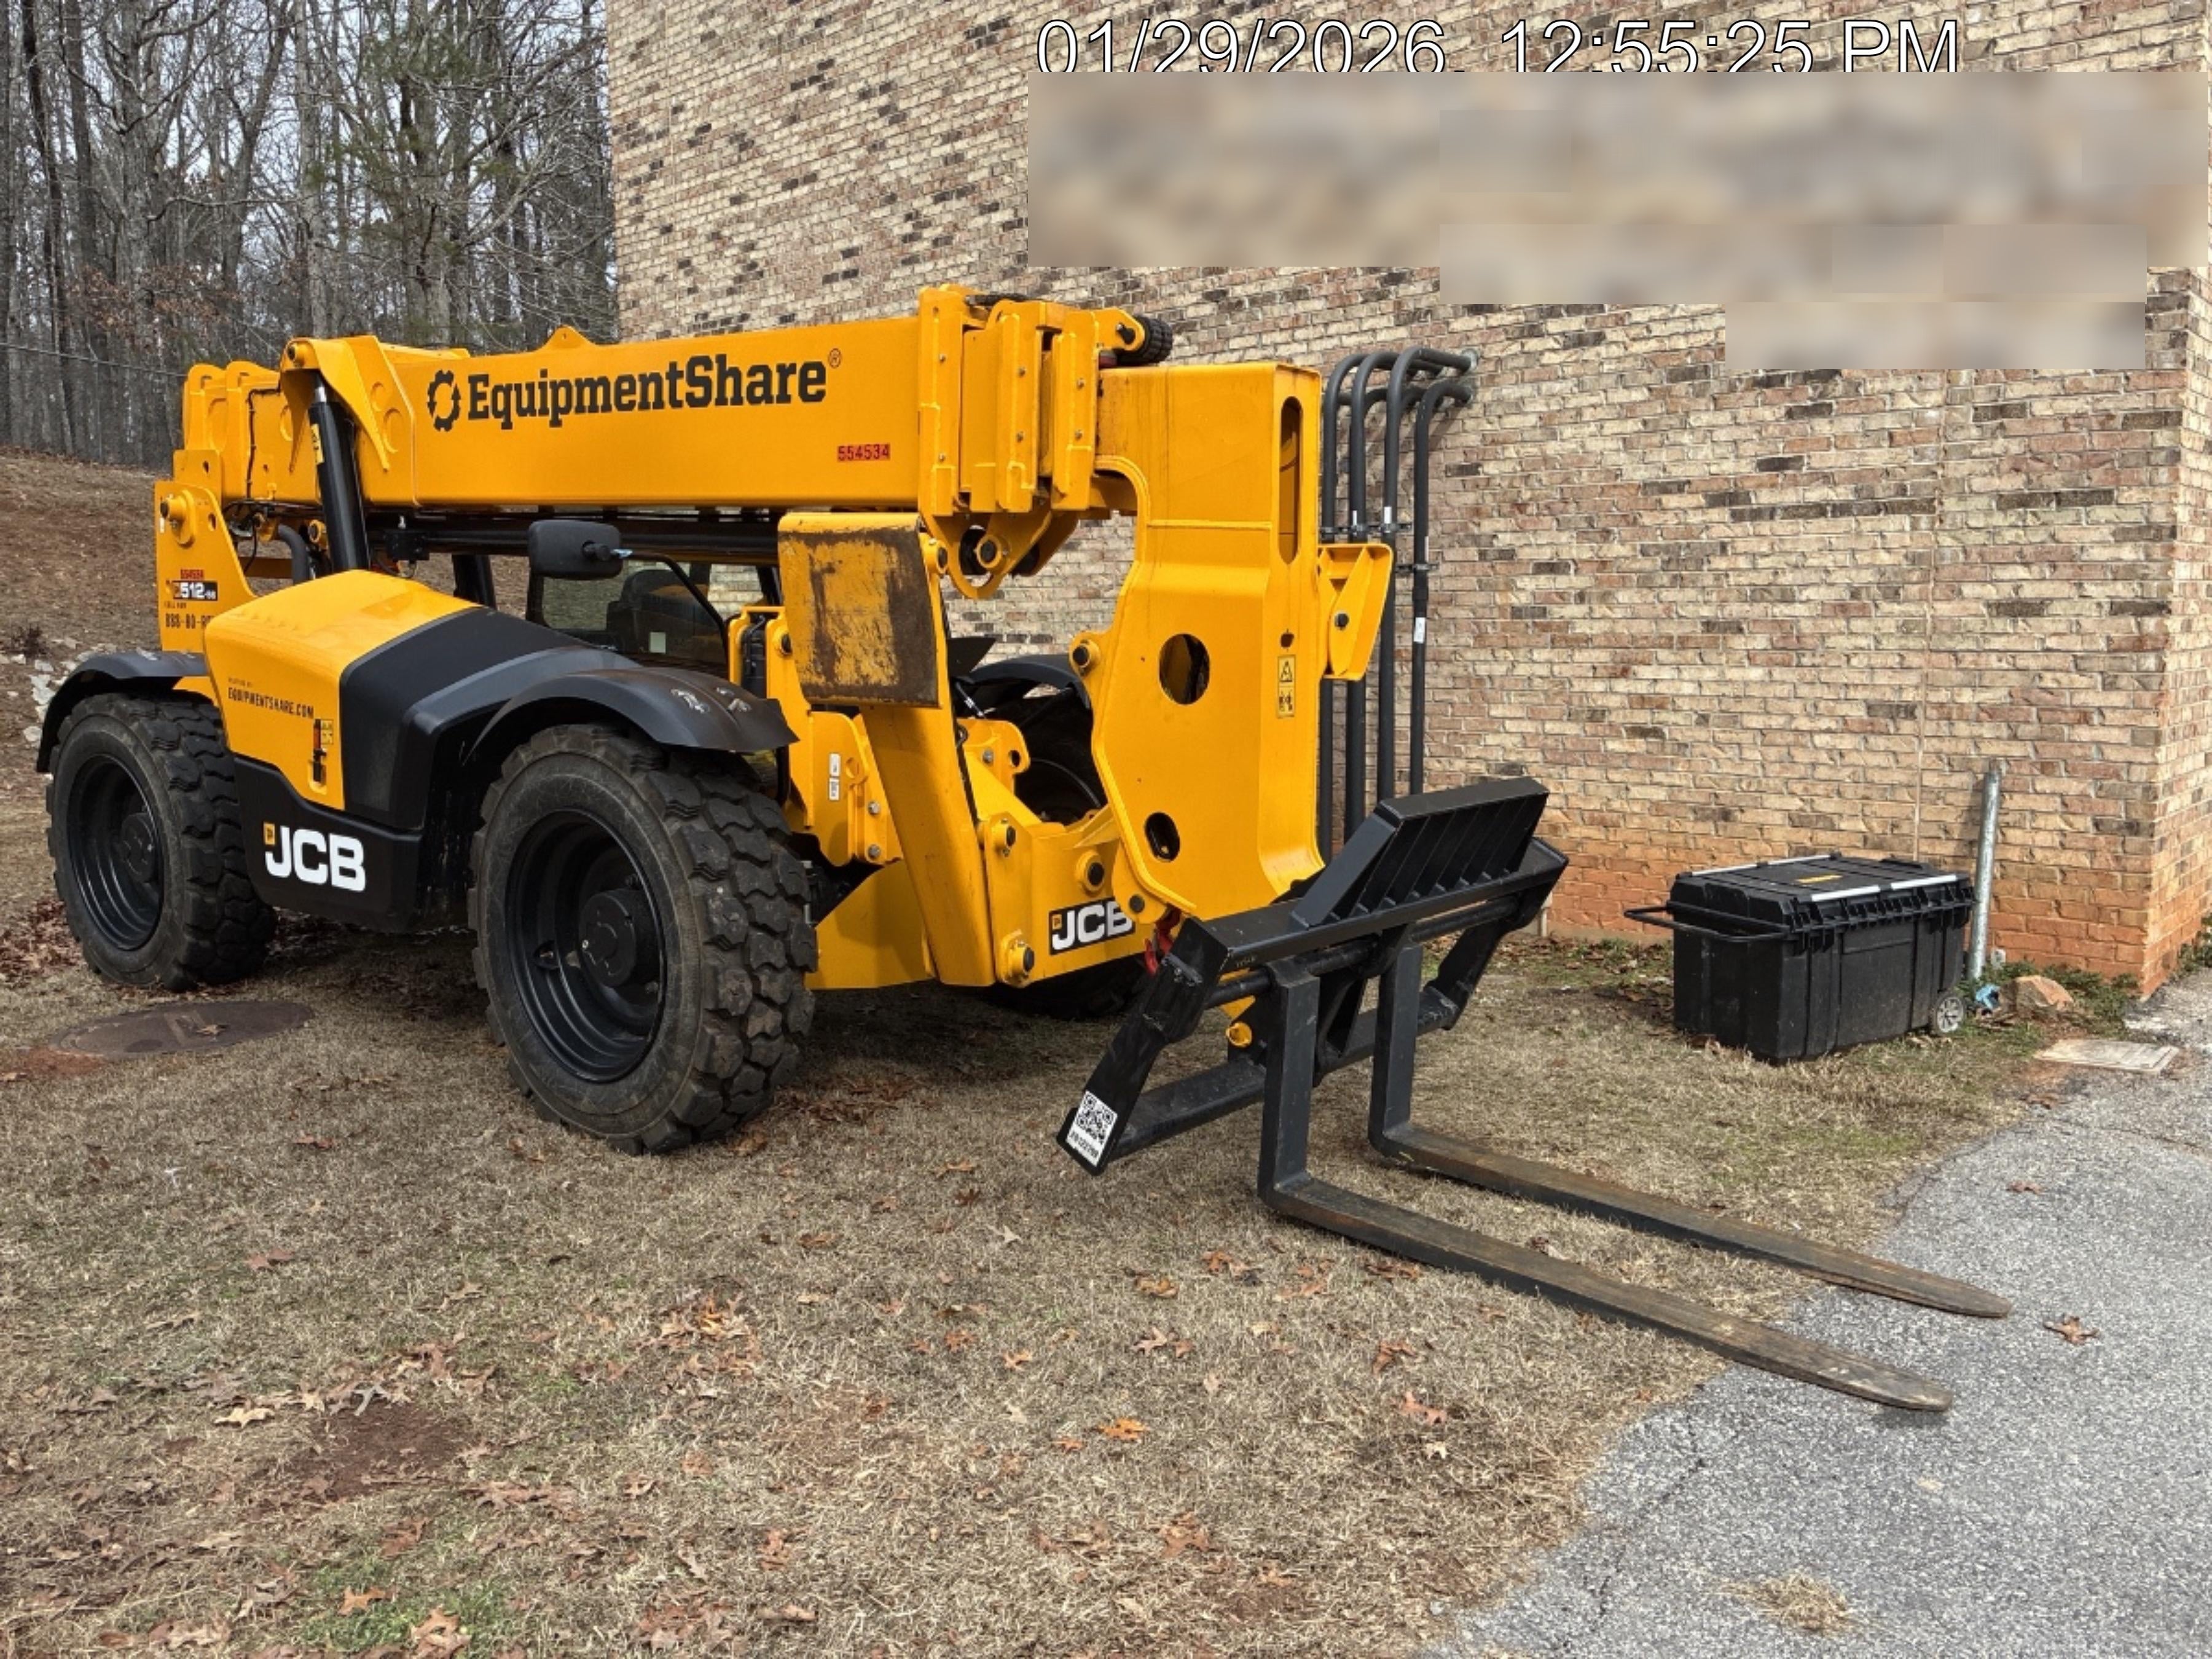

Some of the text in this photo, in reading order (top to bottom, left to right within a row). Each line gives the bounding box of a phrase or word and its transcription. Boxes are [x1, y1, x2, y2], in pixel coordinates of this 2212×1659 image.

[837, 444, 890, 461] 554534
[228, 687, 314, 719] EQUIPMENTSHARE.COM
[265, 825, 366, 892] JCB
[1051, 900, 1132, 950] JCB
